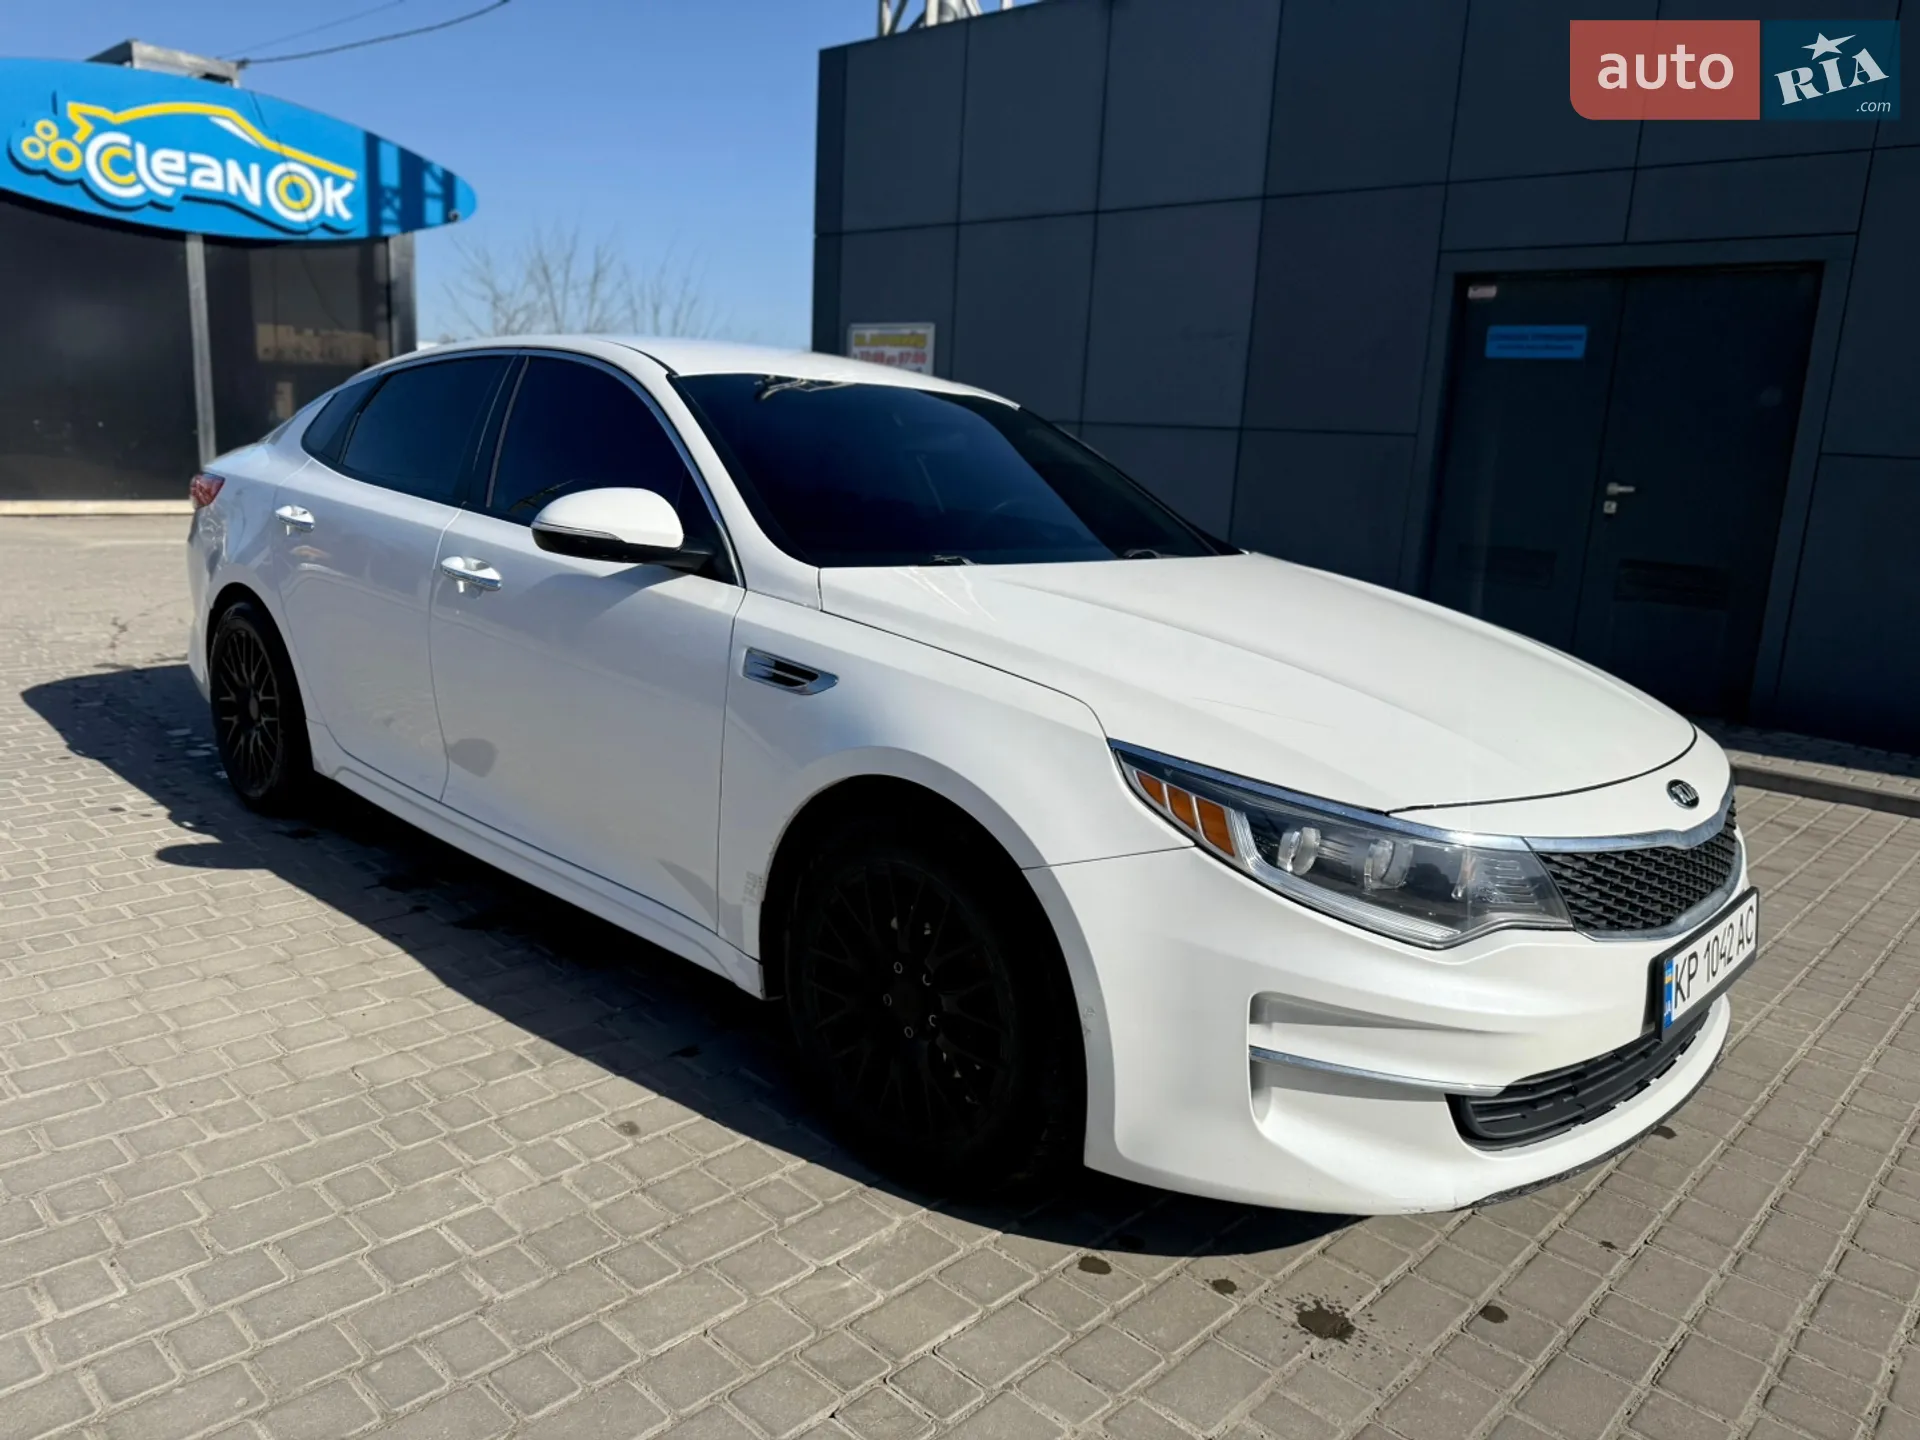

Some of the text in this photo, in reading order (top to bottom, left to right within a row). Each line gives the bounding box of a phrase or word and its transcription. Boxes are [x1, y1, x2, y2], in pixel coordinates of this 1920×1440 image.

[1674, 906, 1754, 1009] KP 1042 AC
